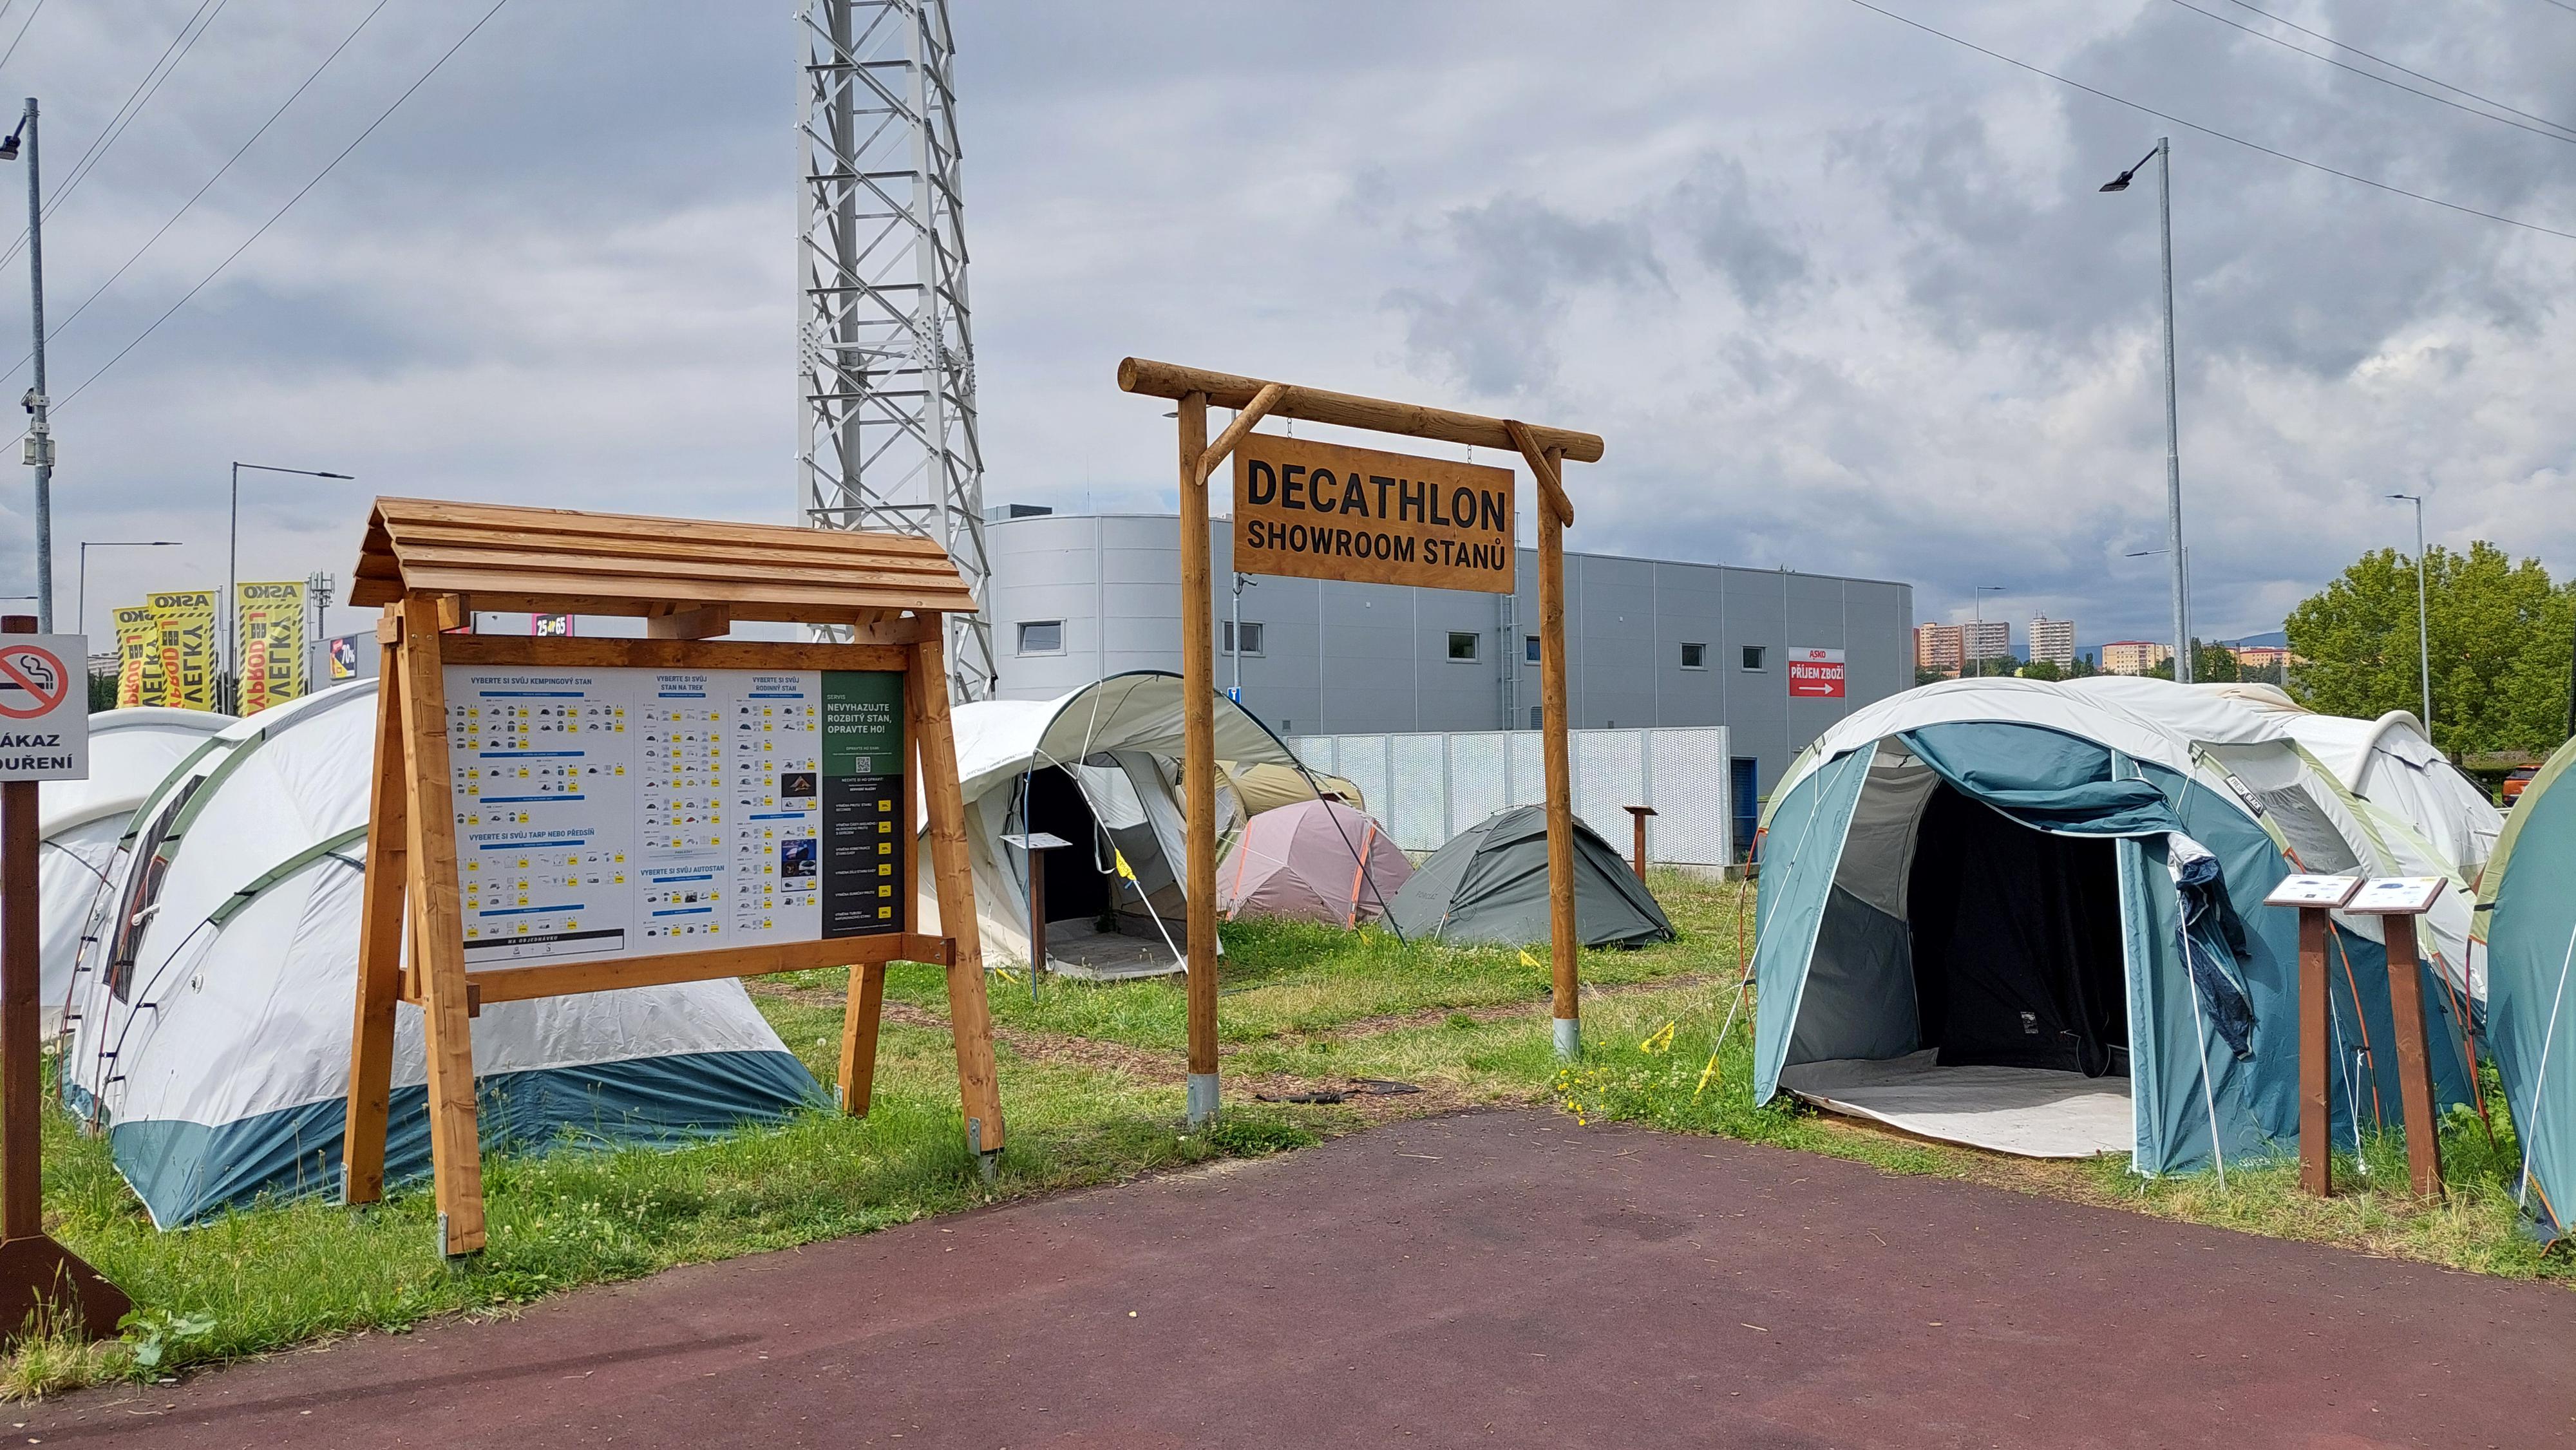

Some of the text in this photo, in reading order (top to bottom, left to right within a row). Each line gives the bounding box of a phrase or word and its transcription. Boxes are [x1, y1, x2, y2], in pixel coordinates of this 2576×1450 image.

[1248, 459, 1505, 532] DECATHLON
[1247, 520, 1505, 571] SHOWROOM STANŮ
[556, 616, 565, 634] 65
[341, 644, 355, 664] 70%
[1809, 650, 1826, 659] ASKO
[1791, 664, 1844, 679] PŘÍJEM ZBOŽÍ
[511, 676, 528, 684] SVŮJ
[530, 677, 574, 685] KEMPINGOVÝ
[827, 703, 890, 711] NEVYHAZUJTE
[828, 713, 892, 724] ROZBITÝ STAN,
[870, 725, 885, 733] HO!
[0, 753, 73, 770] UŘENÍ
[2230, 778, 2245, 793] FRESH
[2245, 794, 2261, 810] BLACK
[509, 831, 527, 839] SVŮJ
[676, 865, 692, 874] SVŮJ
[693, 865, 725, 873] AUTOSTAN
